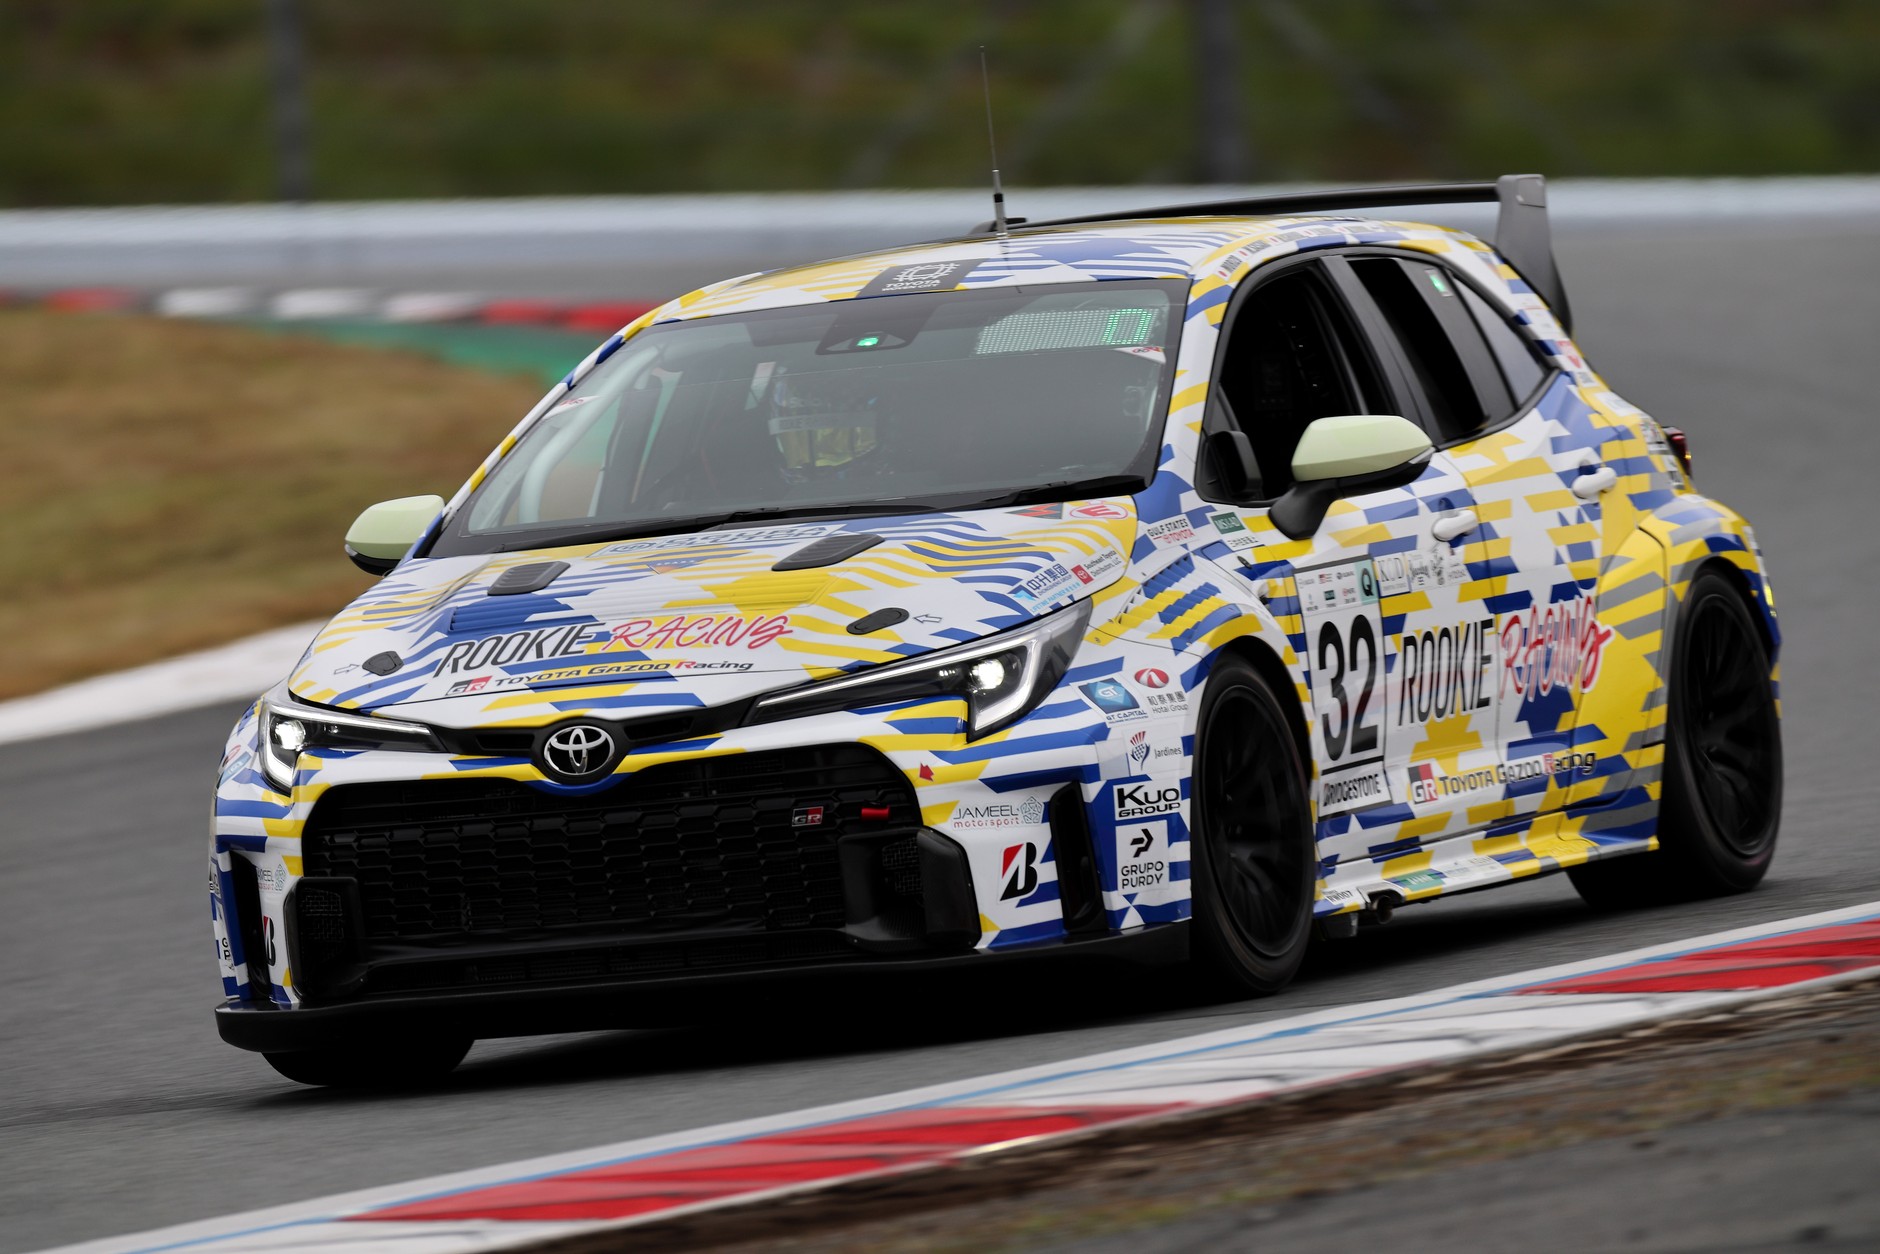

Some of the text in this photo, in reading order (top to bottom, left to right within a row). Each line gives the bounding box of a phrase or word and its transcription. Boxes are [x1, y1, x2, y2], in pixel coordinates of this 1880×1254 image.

[887, 280, 940, 288] TOYOTA
[1147, 518, 1189, 537] GULF STATES
[1170, 529, 1195, 541] TOYOTA
[1083, 550, 1117, 570] Southeast Toyota
[1026, 563, 1069, 591] 中升集团
[1361, 567, 1374, 597] Q
[433, 615, 794, 678] ROOKIE RACING
[1398, 595, 1615, 726] ROOKIE RACING
[447, 660, 754, 695] GR TOYOTA GAZOO Racing
[1096, 686, 1122, 698] GT
[1318, 614, 1378, 761] 32
[1147, 690, 1186, 706] 和泰集團
[1117, 710, 1148, 719] CAPITAL
[1170, 702, 1189, 712] Group
[1154, 747, 1182, 759] Jardines
[1412, 752, 1596, 804] GR TOYOTA GAZOO Racing
[1117, 785, 1180, 808] KUO
[953, 804, 1018, 820] JAMEEL
[1118, 802, 1181, 818] GROUP
[794, 813, 822, 825] GR
[953, 817, 1019, 828] motorsport
[1121, 860, 1164, 877] GRUPO
[1121, 873, 1163, 889] PURDY
